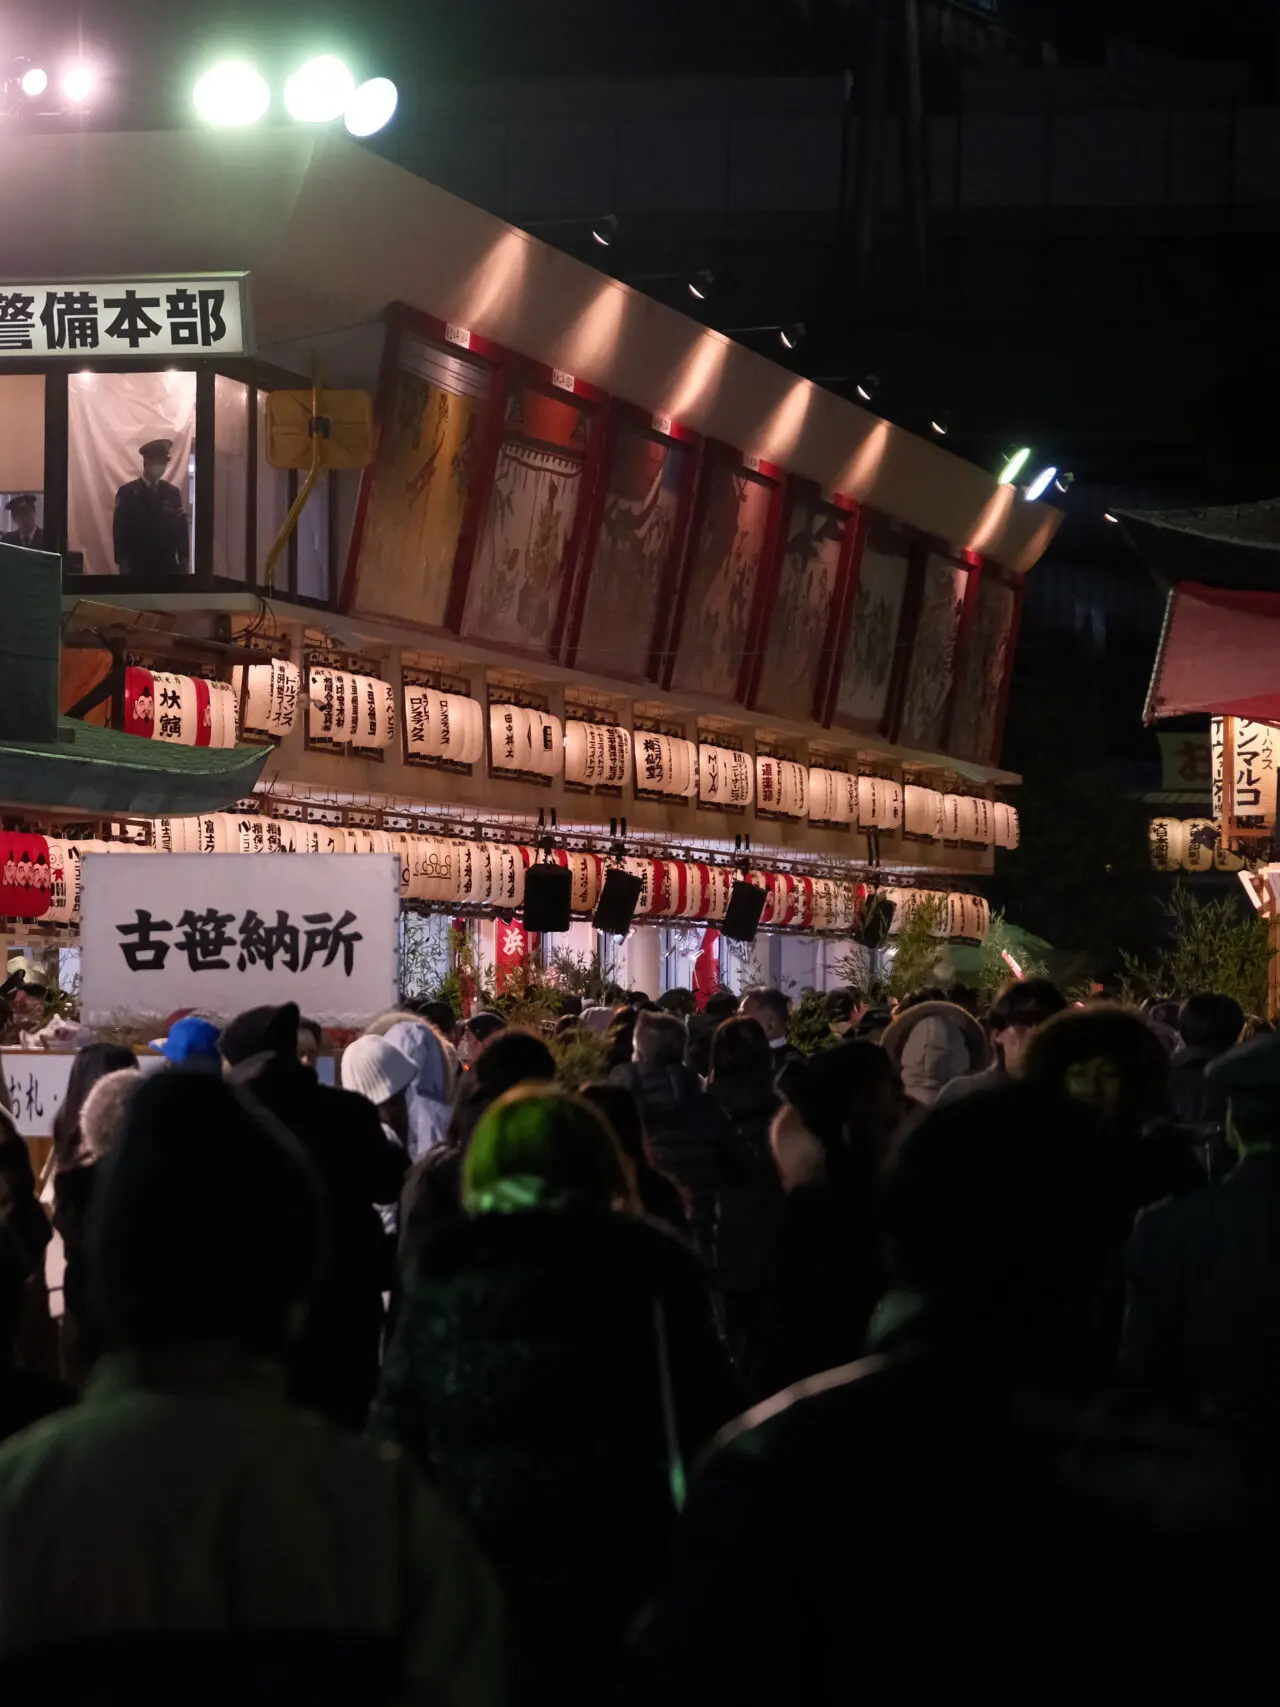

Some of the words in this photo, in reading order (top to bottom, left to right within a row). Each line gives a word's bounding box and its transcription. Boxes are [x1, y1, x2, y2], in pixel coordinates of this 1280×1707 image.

[708, 755, 717, 793] MIYA
[116, 907, 364, 978] 古笹納所
